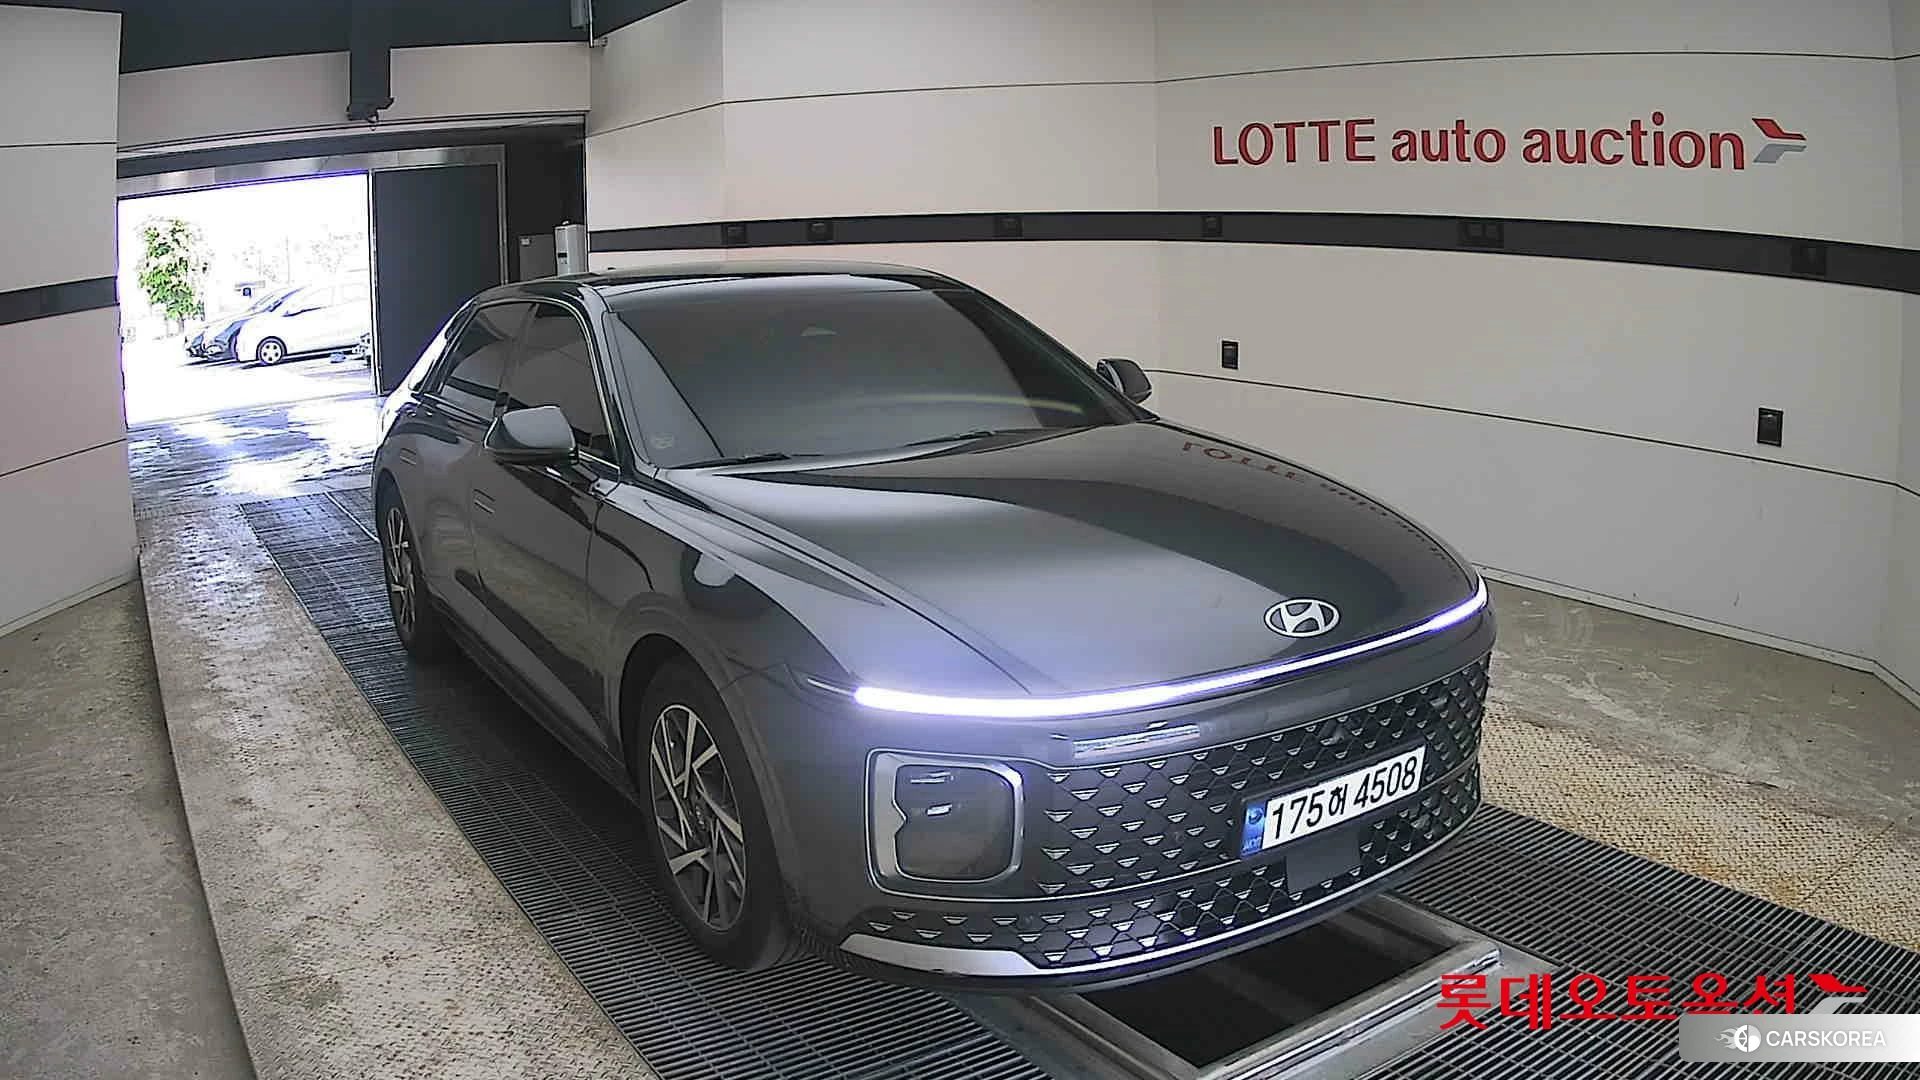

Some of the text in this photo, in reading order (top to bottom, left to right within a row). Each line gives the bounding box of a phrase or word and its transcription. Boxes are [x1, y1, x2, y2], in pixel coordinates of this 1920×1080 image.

[1213, 111, 1745, 169] LOTTE auto auction
[1272, 755, 1418, 840] 175허 4508
